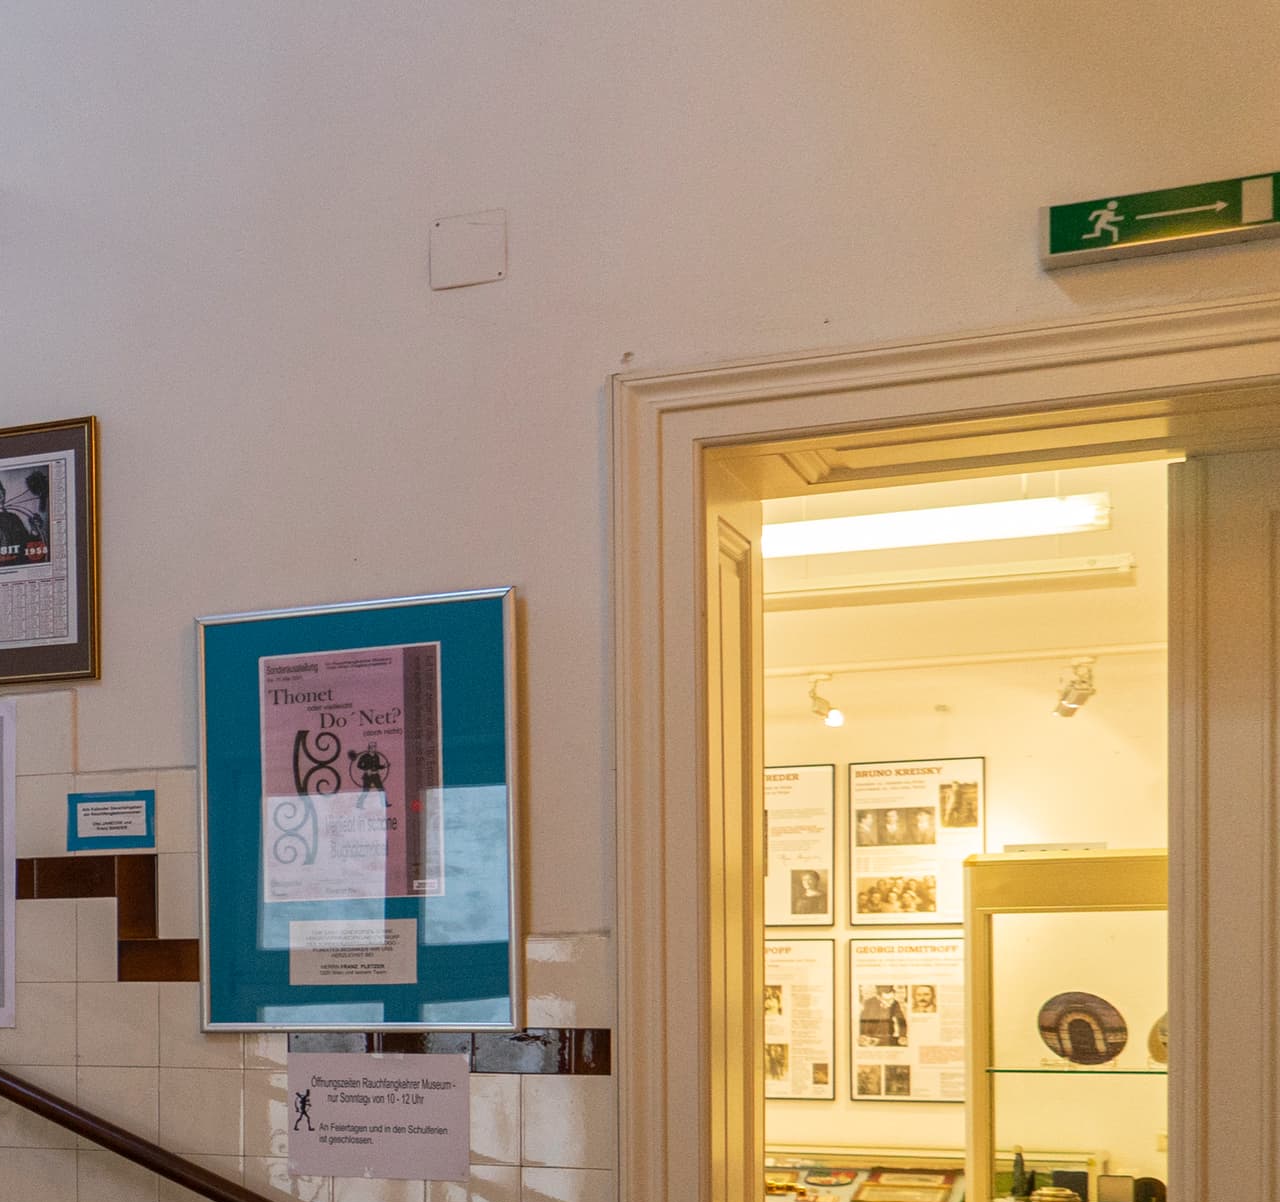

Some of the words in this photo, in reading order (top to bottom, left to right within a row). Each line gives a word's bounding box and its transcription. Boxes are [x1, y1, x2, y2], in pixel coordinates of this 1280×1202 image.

[268, 689, 333, 705] Thonet
[320, 712, 348, 729] Do
[855, 769, 893, 778] BRUNO
[895, 766, 943, 776] KREISKY
[856, 945, 896, 954] GEORGI
[897, 945, 958, 954] DIMITROFF
[311, 1075, 361, 1090] Öffnungszeiten
[362, 1077, 420, 1091] Rauchfangkehrer
[421, 1078, 451, 1090] Museum
[327, 1094, 338, 1103] nur
[372, 1096, 385, 1104] von
[386, 1093, 395, 1104] 10
[402, 1093, 410, 1105] 12
[411, 1094, 425, 1105] Uhr
[319, 1123, 329, 1131] An
[330, 1123, 368, 1134] Feiertagen
[369, 1124, 383, 1133] und
[384, 1125, 391, 1133] in
[392, 1125, 406, 1134] den
[407, 1125, 449, 1135] Schulferien
[329, 1135, 374, 1146] geschlossen.
